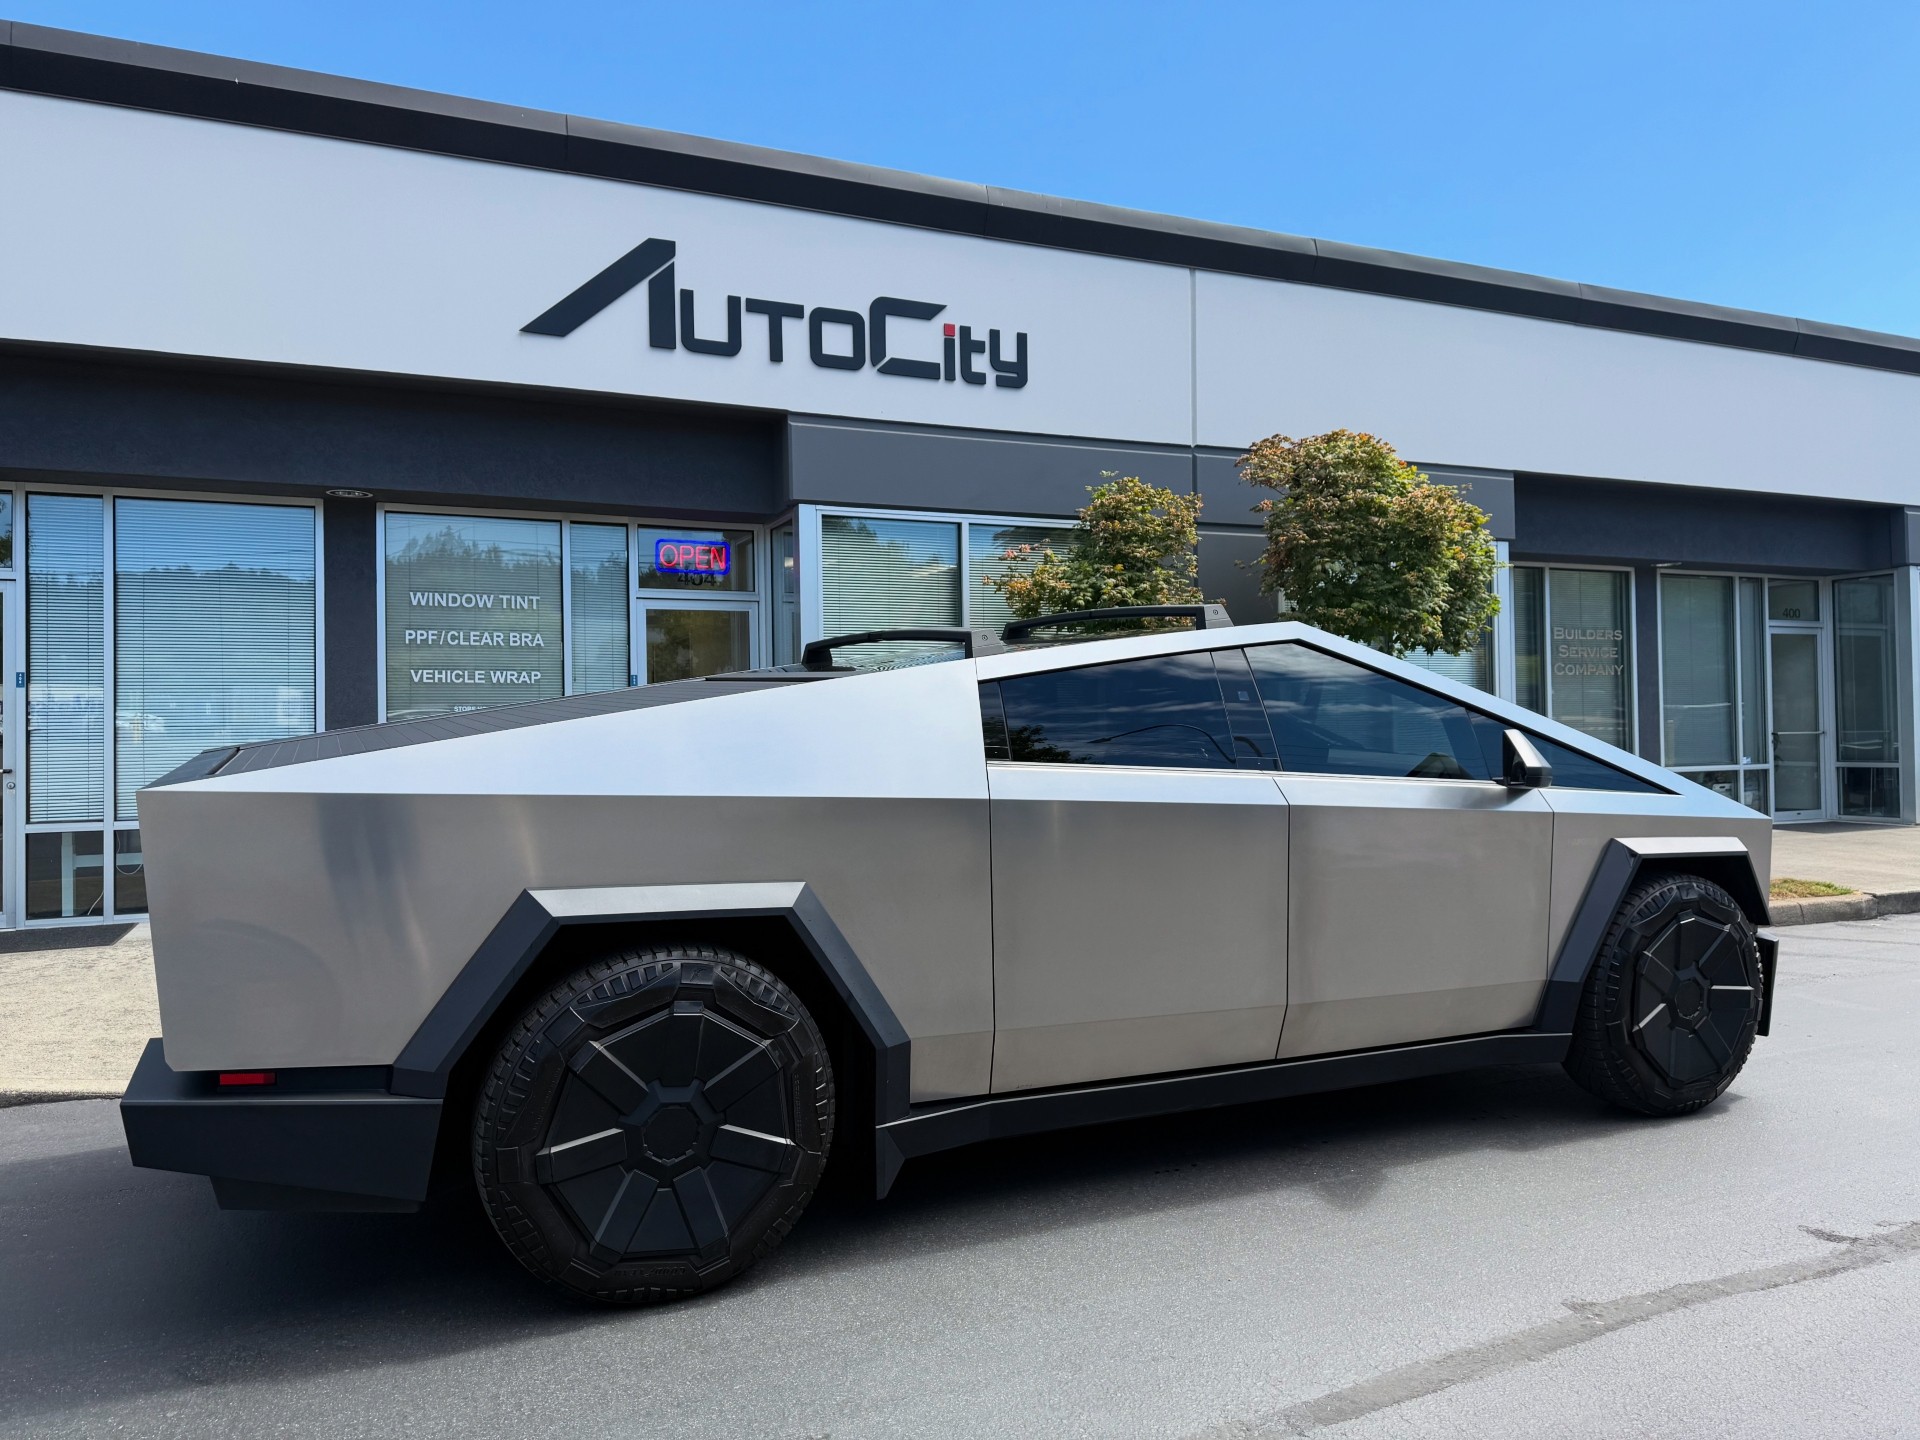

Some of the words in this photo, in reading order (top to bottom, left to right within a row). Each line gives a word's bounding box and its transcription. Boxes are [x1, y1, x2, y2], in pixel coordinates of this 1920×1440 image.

[660, 544, 726, 569] OPEN
[410, 591, 494, 609] WINDOW
[499, 595, 540, 610] TINT
[1782, 608, 1801, 619] 400
[405, 630, 504, 646] PPF/CLEAR
[509, 632, 545, 647] BRA
[410, 669, 486, 683] VEHICLE
[490, 670, 541, 684] WRAP
